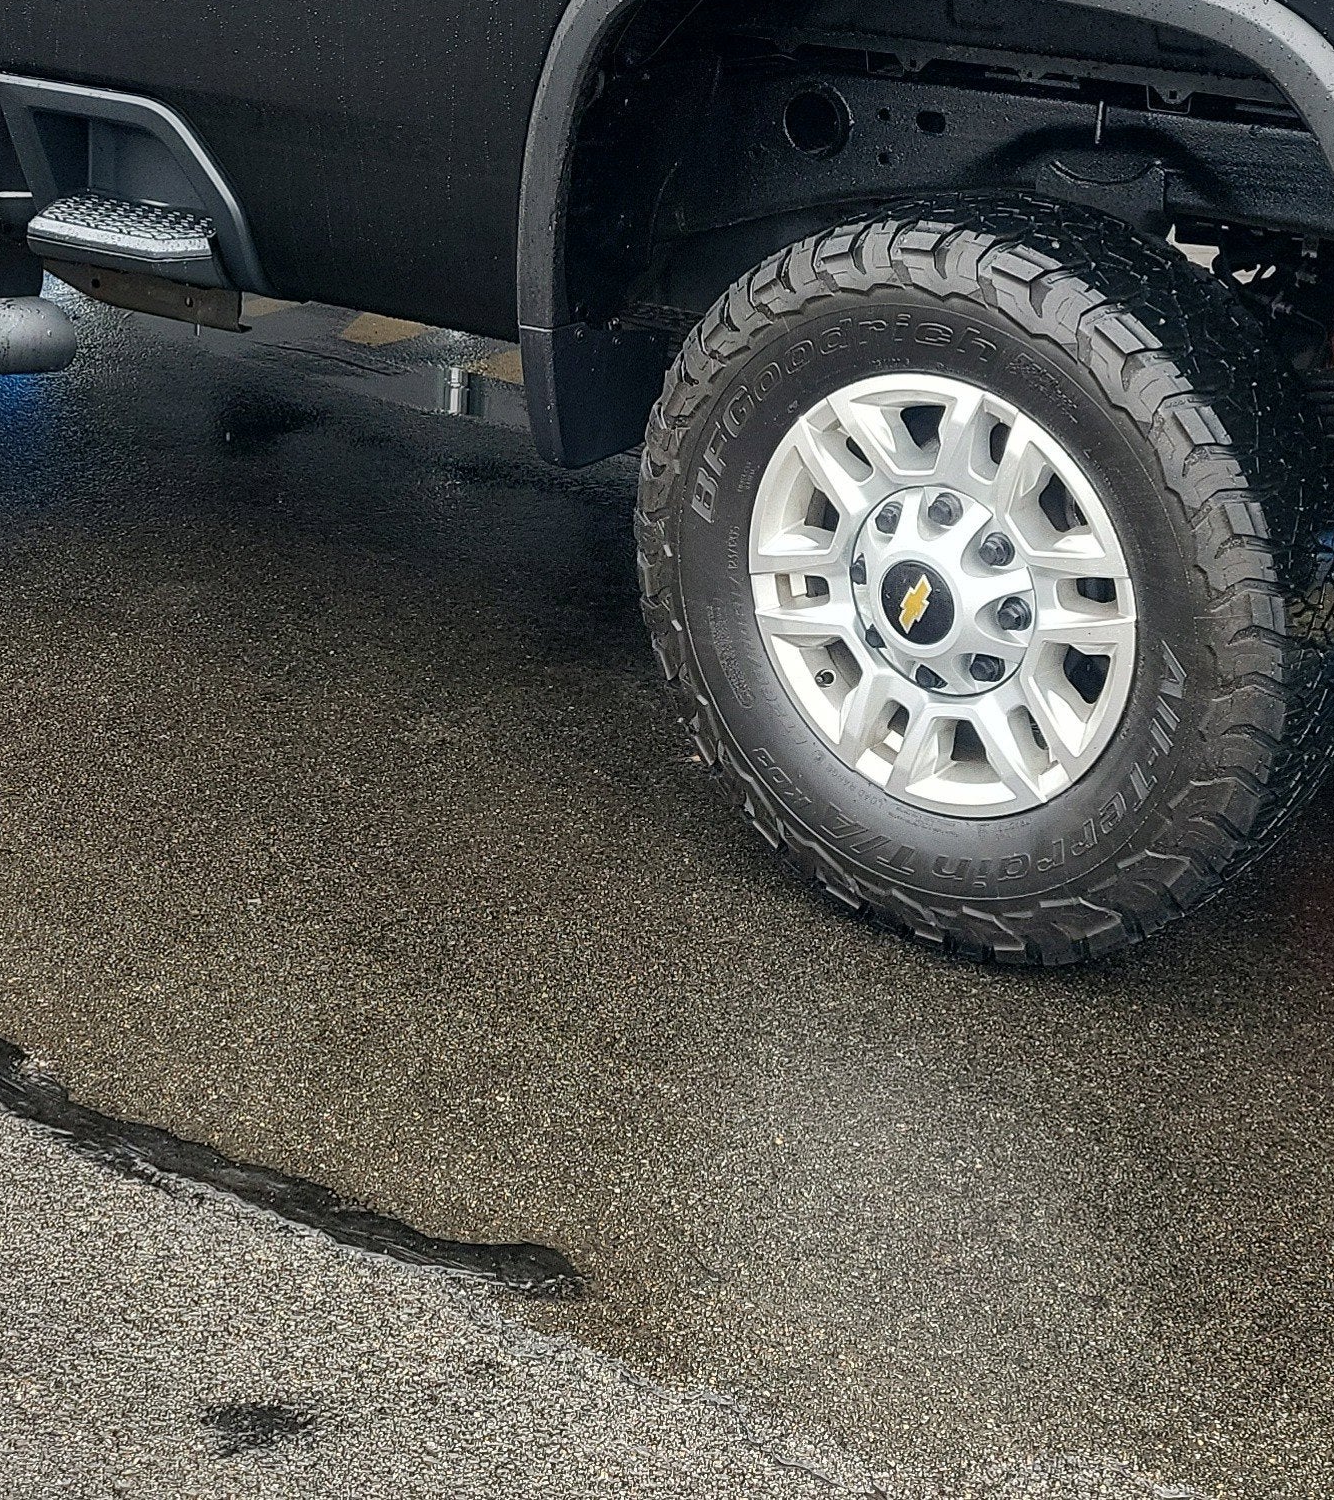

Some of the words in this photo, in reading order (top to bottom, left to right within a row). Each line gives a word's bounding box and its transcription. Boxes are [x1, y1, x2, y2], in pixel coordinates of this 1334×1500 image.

[691, 313, 998, 524] BFGoodrich
[820, 802, 916, 876] T/A
[932, 639, 1188, 888] All-Terrain
